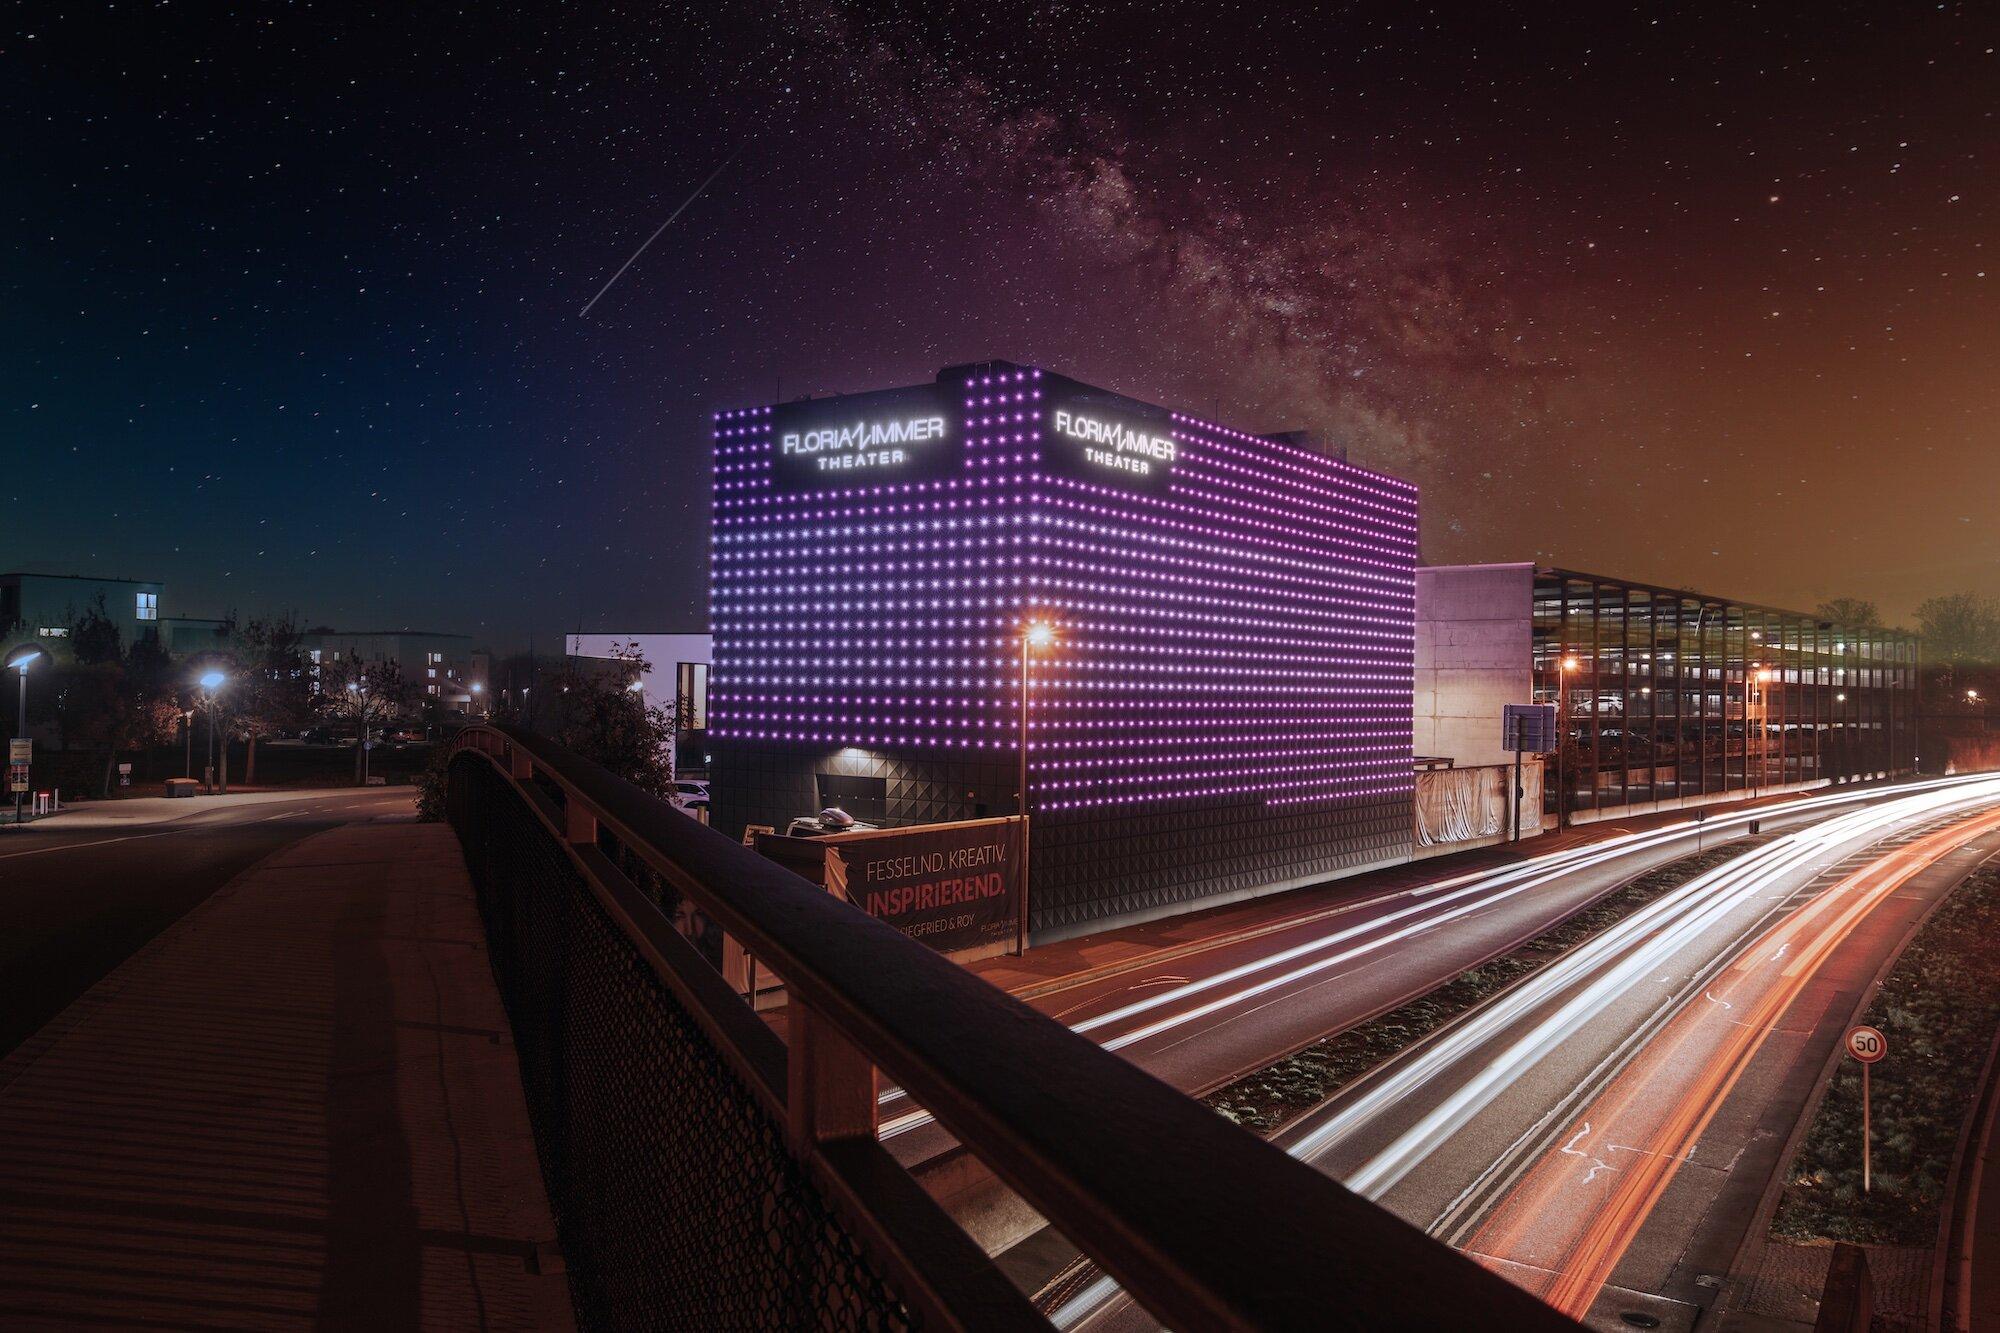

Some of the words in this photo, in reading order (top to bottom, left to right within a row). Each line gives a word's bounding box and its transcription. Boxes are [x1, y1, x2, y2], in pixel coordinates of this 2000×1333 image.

[818, 450, 904, 470] THEATER
[1085, 447, 1149, 474] THEATER
[866, 852, 946, 882] FESSELND.
[949, 844, 1006, 870] KREATIV.
[866, 872, 1006, 918] INSPIRIEREND.
[948, 917, 956, 930] &
[957, 913, 976, 928] ROY
[1855, 1035, 1878, 1053] 50
